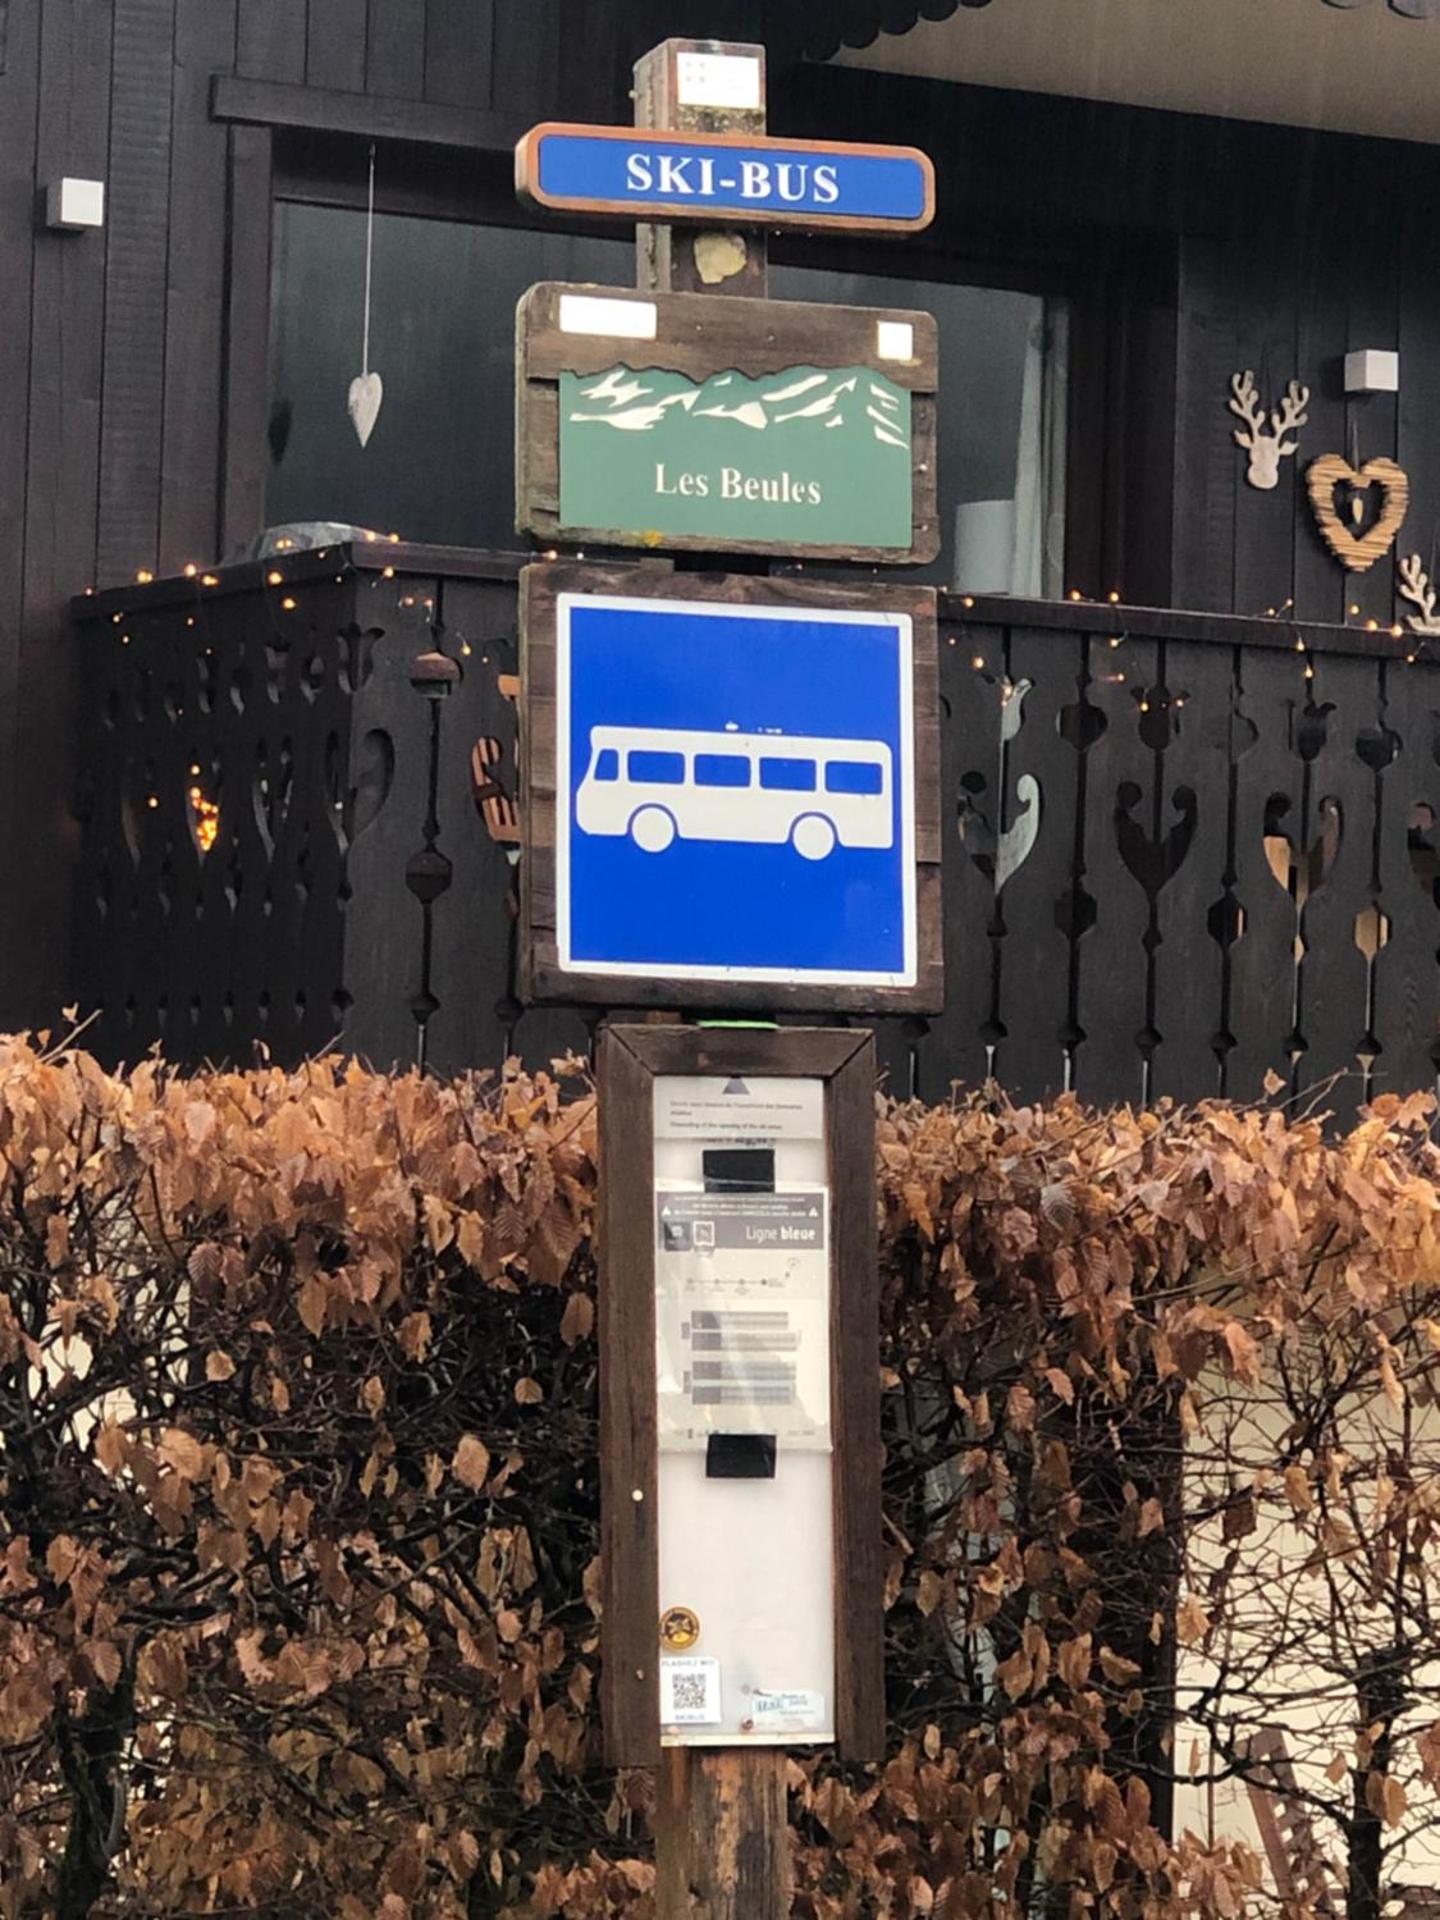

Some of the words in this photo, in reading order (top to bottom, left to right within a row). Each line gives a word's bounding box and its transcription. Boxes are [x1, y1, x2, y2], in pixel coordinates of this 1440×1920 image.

[626, 153, 840, 203] SKI-BUS
[655, 463, 709, 497] Les
[721, 466, 822, 504] Beules
[746, 1226, 778, 1244] Ligne
[780, 1226, 816, 1241] bleue
